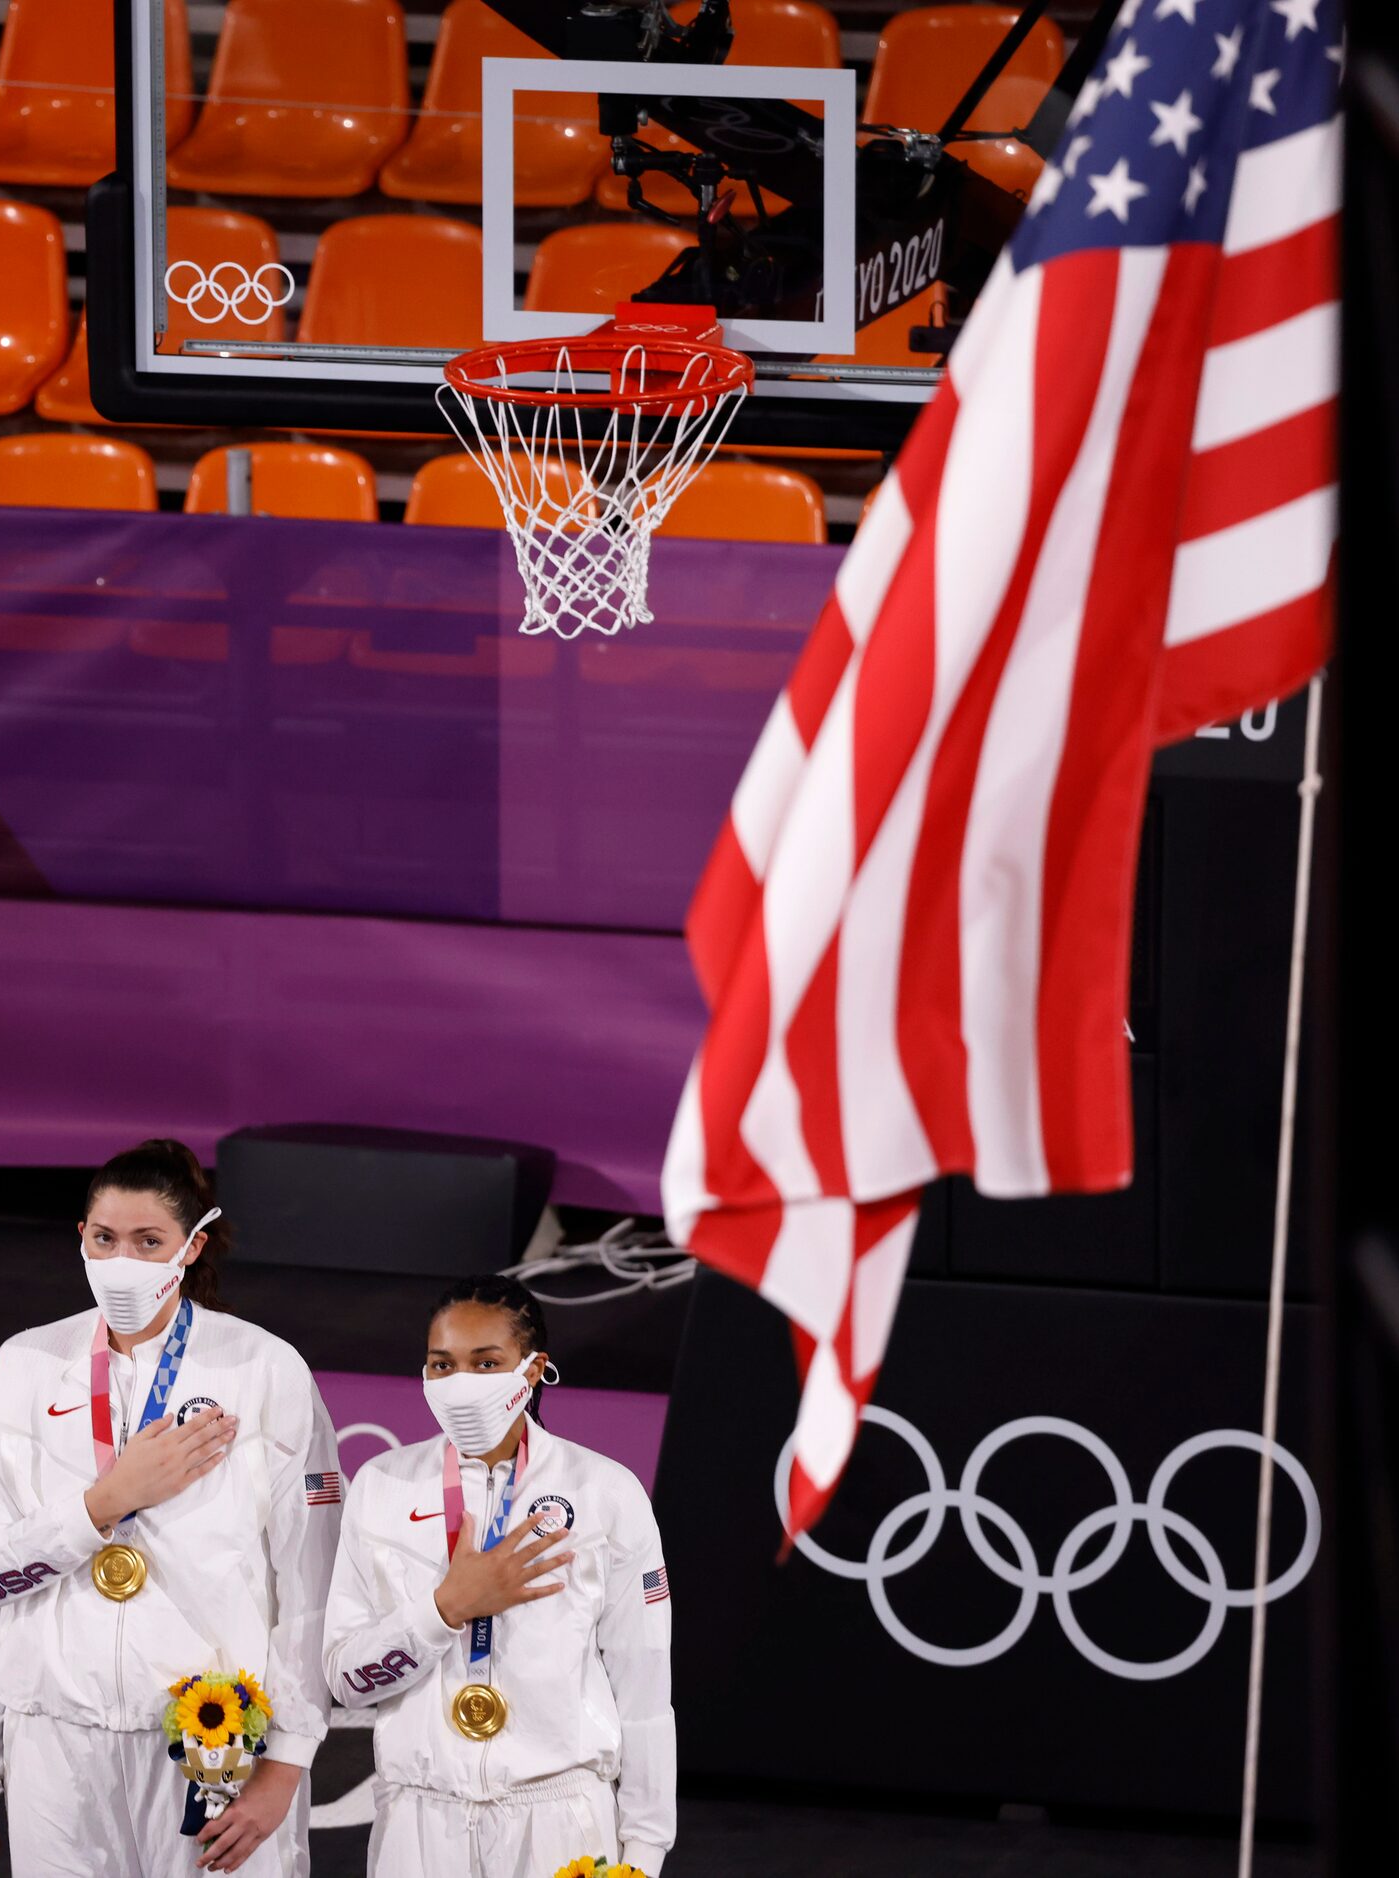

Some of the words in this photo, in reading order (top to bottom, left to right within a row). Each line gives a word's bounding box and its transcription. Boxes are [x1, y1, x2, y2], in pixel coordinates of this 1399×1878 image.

[887, 217, 944, 305] 2020
[155, 1275, 179, 1300] USA
[505, 1386, 527, 1411] USA
[476, 1618, 489, 1648] TOKY
[342, 1650, 419, 1694] USA
